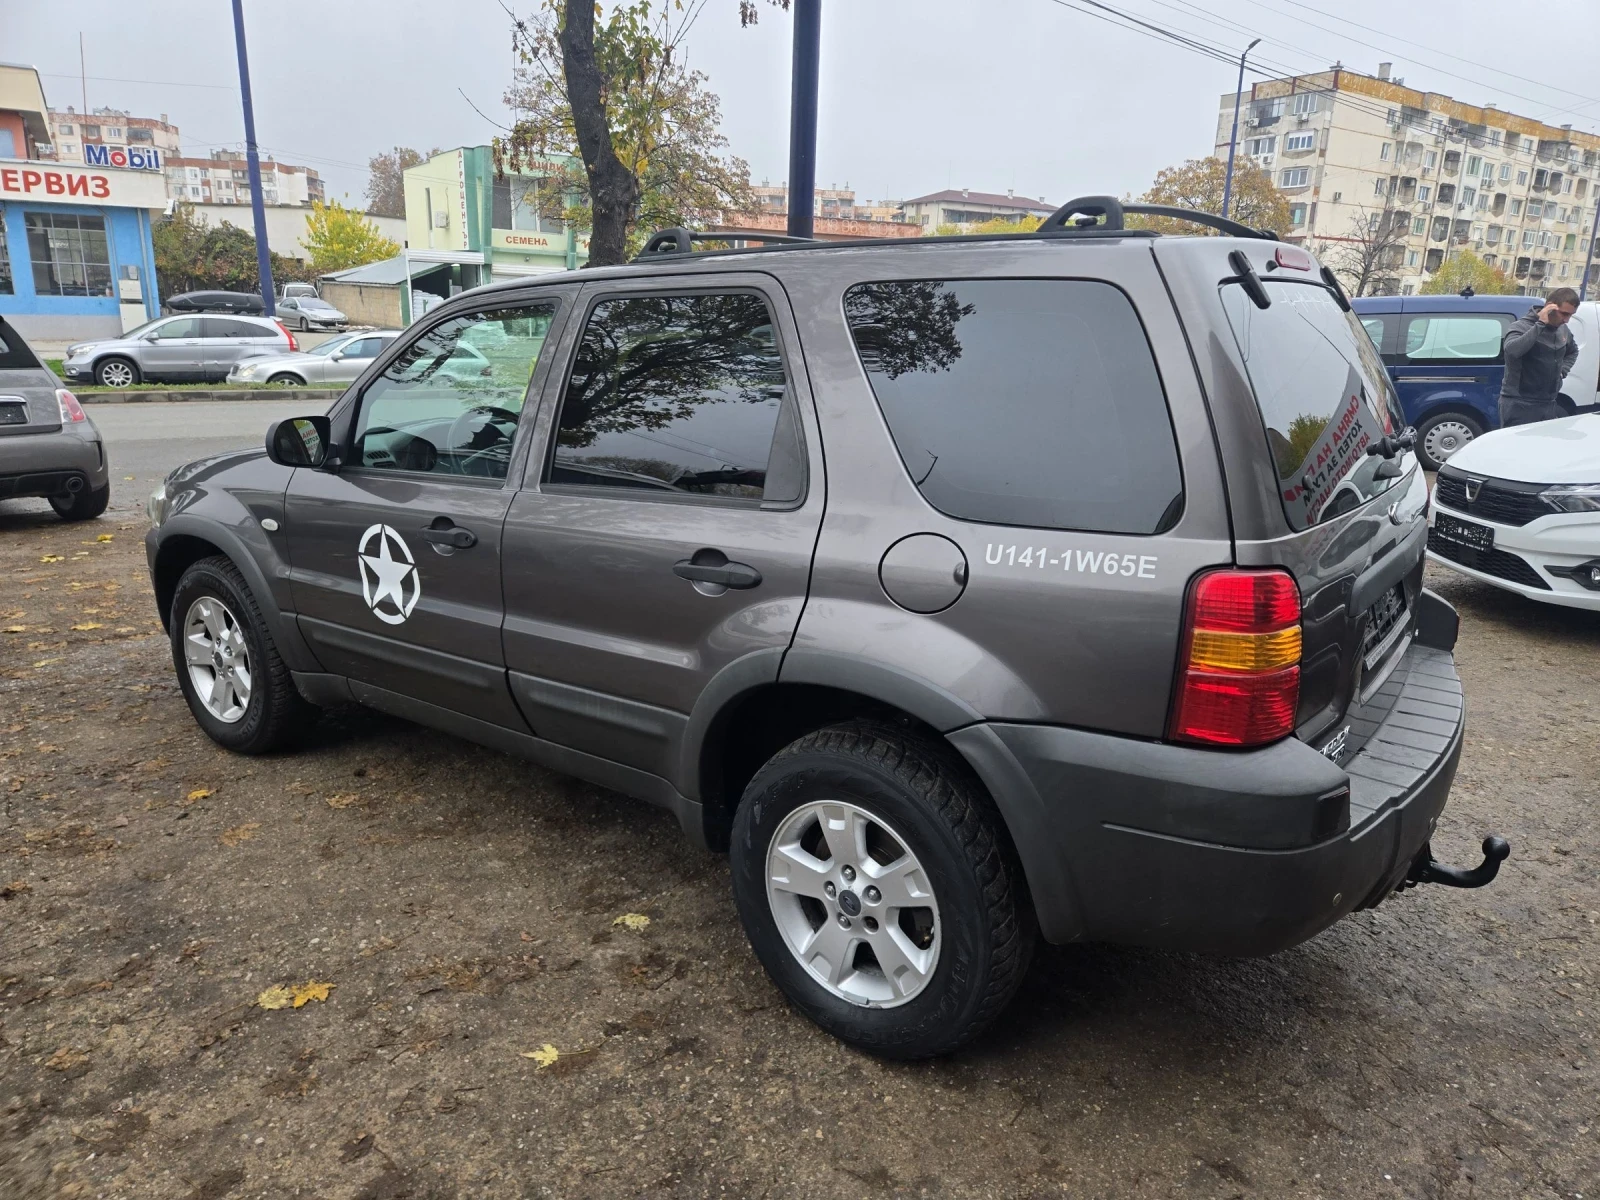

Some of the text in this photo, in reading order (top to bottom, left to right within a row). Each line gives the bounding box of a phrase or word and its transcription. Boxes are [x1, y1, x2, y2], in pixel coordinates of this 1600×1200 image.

[84, 144, 161, 170] Mobil
[457, 151, 468, 249] АГРОЦЕНТЪР
[505, 235, 549, 247] СЕМЕНА
[985, 543, 1158, 579] U141-1W65E
